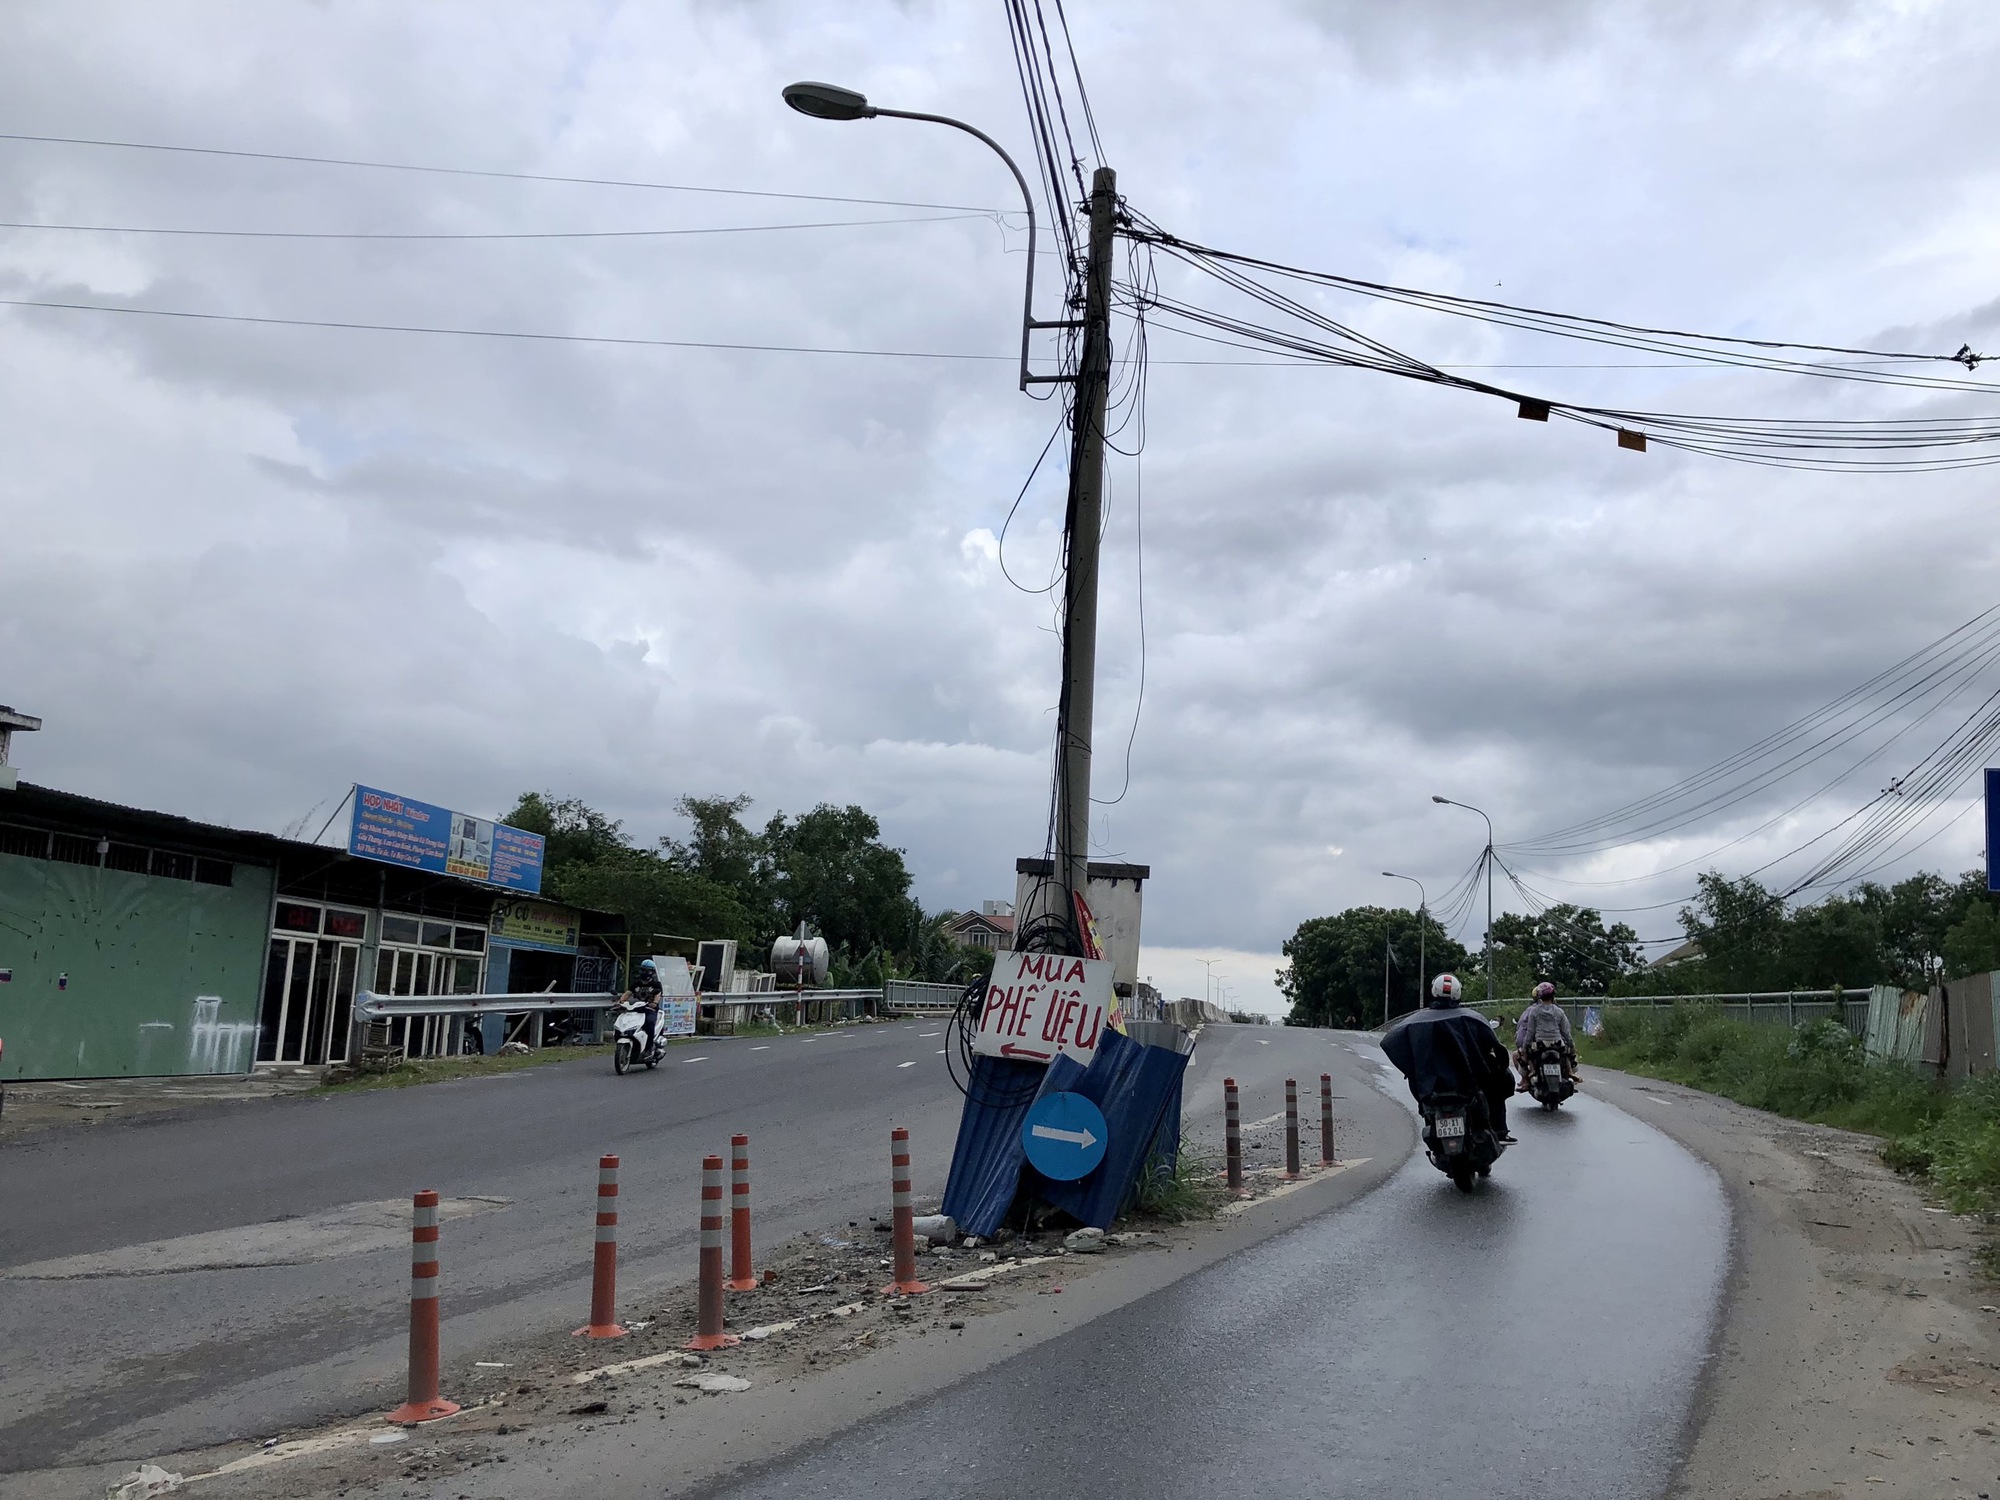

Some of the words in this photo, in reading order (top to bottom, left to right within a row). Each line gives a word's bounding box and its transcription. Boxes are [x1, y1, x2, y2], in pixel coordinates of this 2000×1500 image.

[382, 797, 404, 815] NHẤT
[1017, 955, 1085, 983] MUA
[980, 984, 1046, 1036] PHẾ
[1041, 989, 1102, 1051] LIỆU
